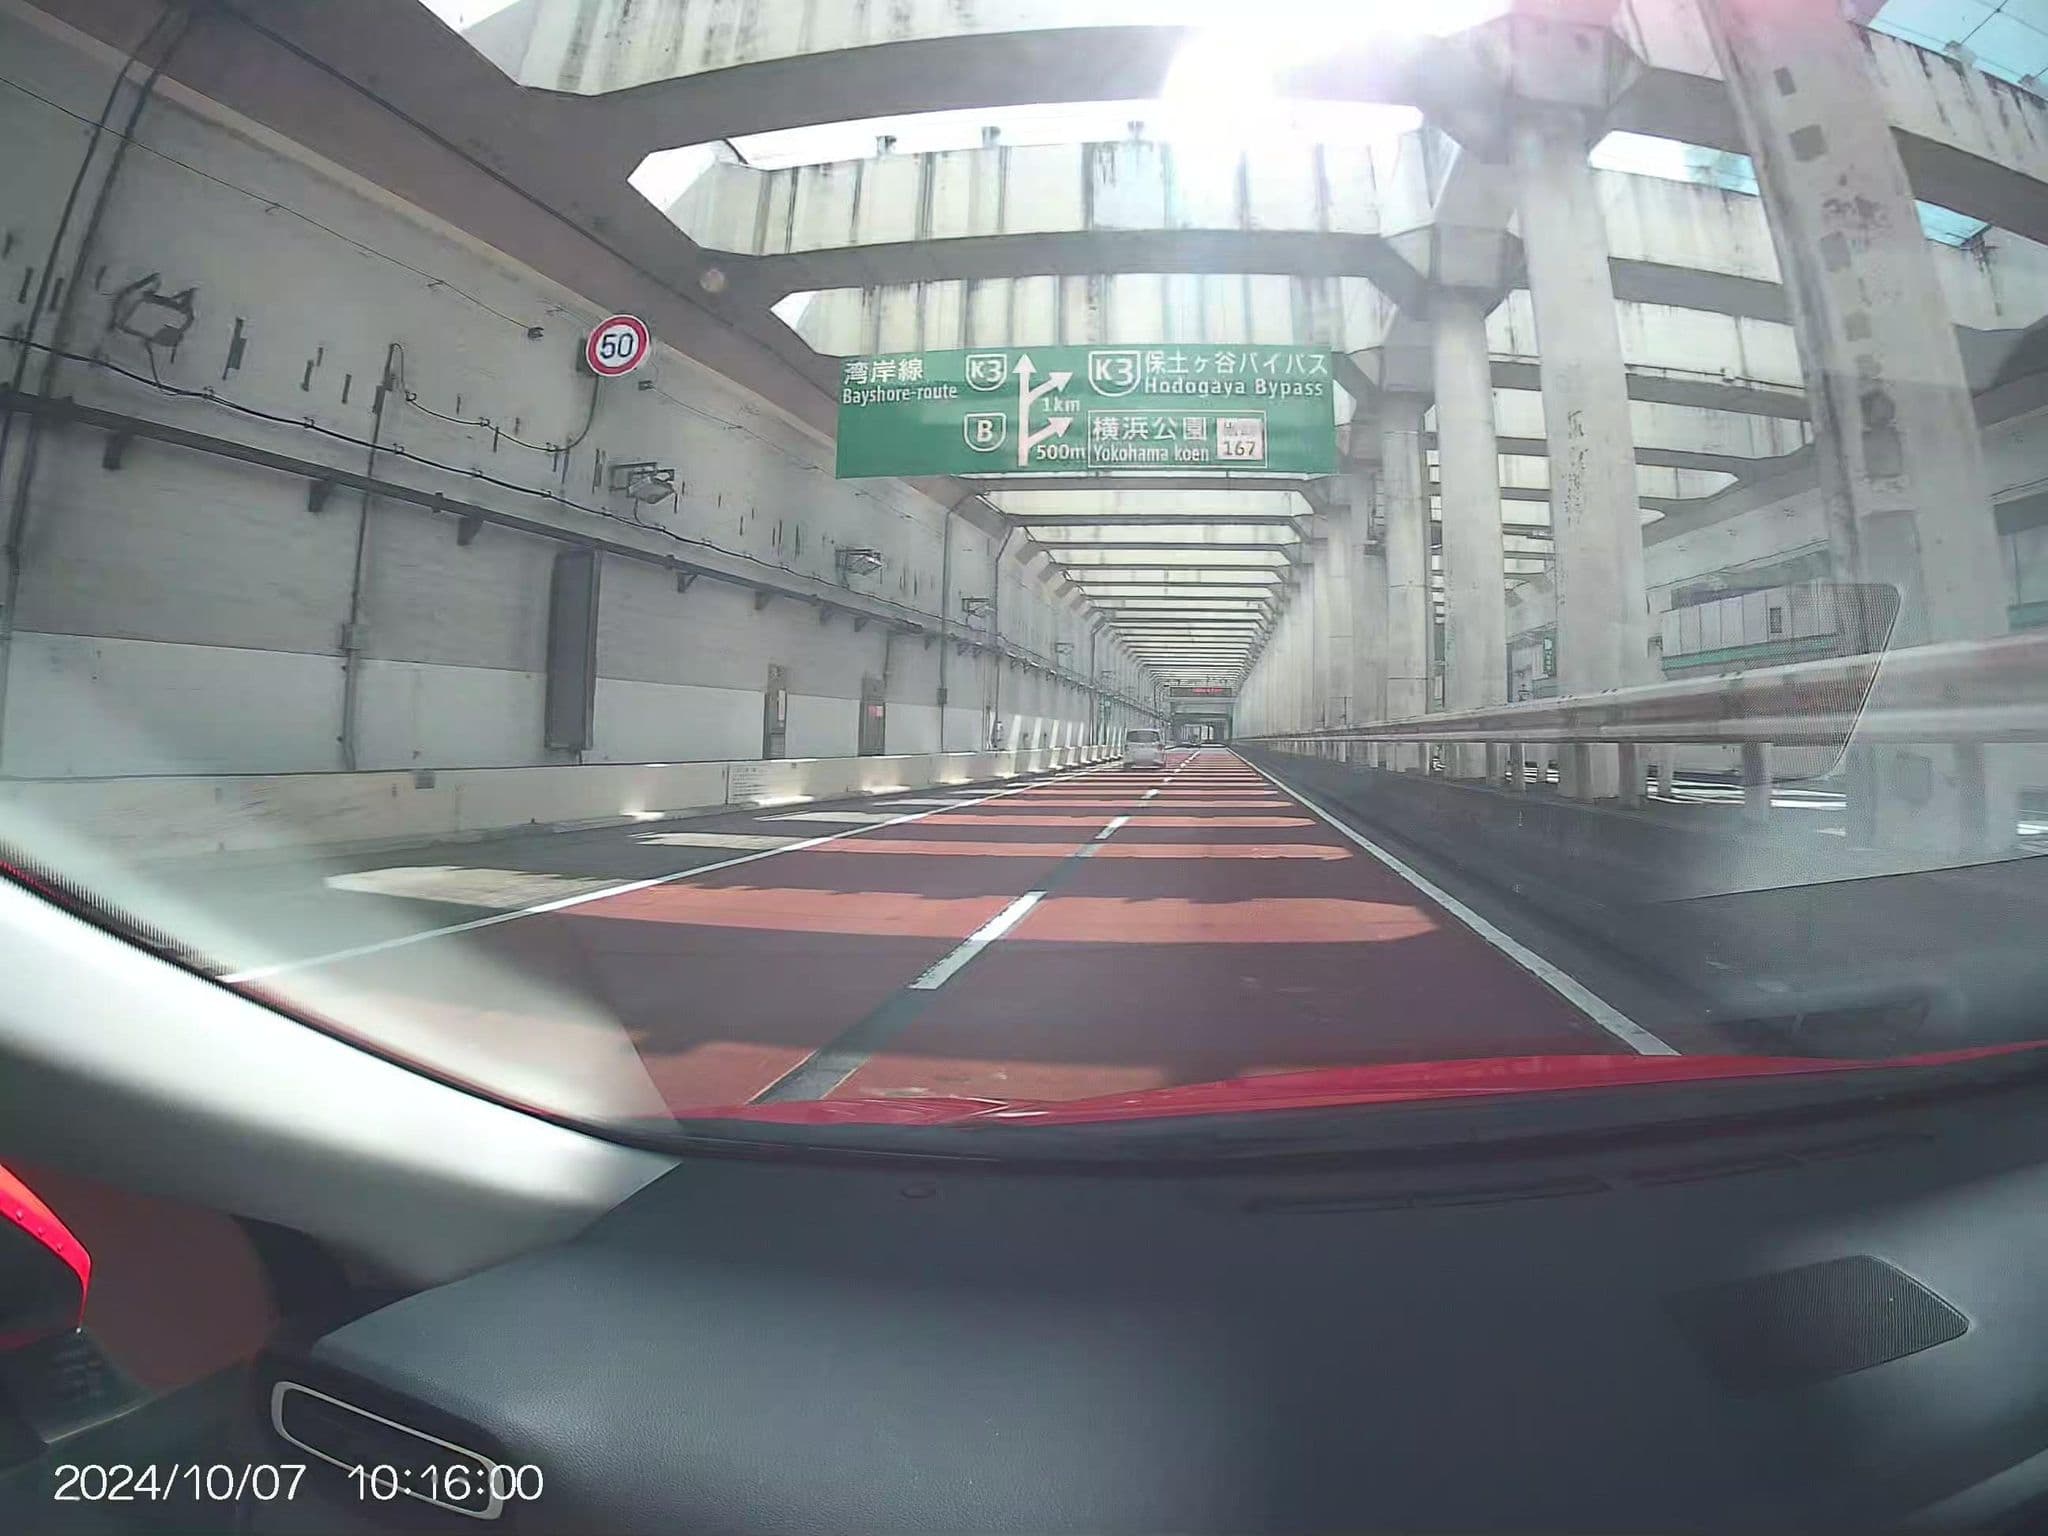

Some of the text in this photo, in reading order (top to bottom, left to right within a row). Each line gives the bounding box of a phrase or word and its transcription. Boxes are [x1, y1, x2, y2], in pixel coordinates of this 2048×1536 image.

[600, 333, 634, 359] 50
[844, 358, 924, 384] 湾岸線
[970, 359, 1001, 383] K3
[1095, 358, 1134, 387] K3
[1144, 376, 1324, 399] Hodogaya Bypass
[1042, 397, 1080, 413] 1km
[976, 419, 994, 443] B
[1092, 415, 1208, 441] 横浜公園
[1036, 444, 1086, 461] 500m
[1094, 443, 1210, 462] Yokohama koen
[1223, 440, 1256, 456] 167
